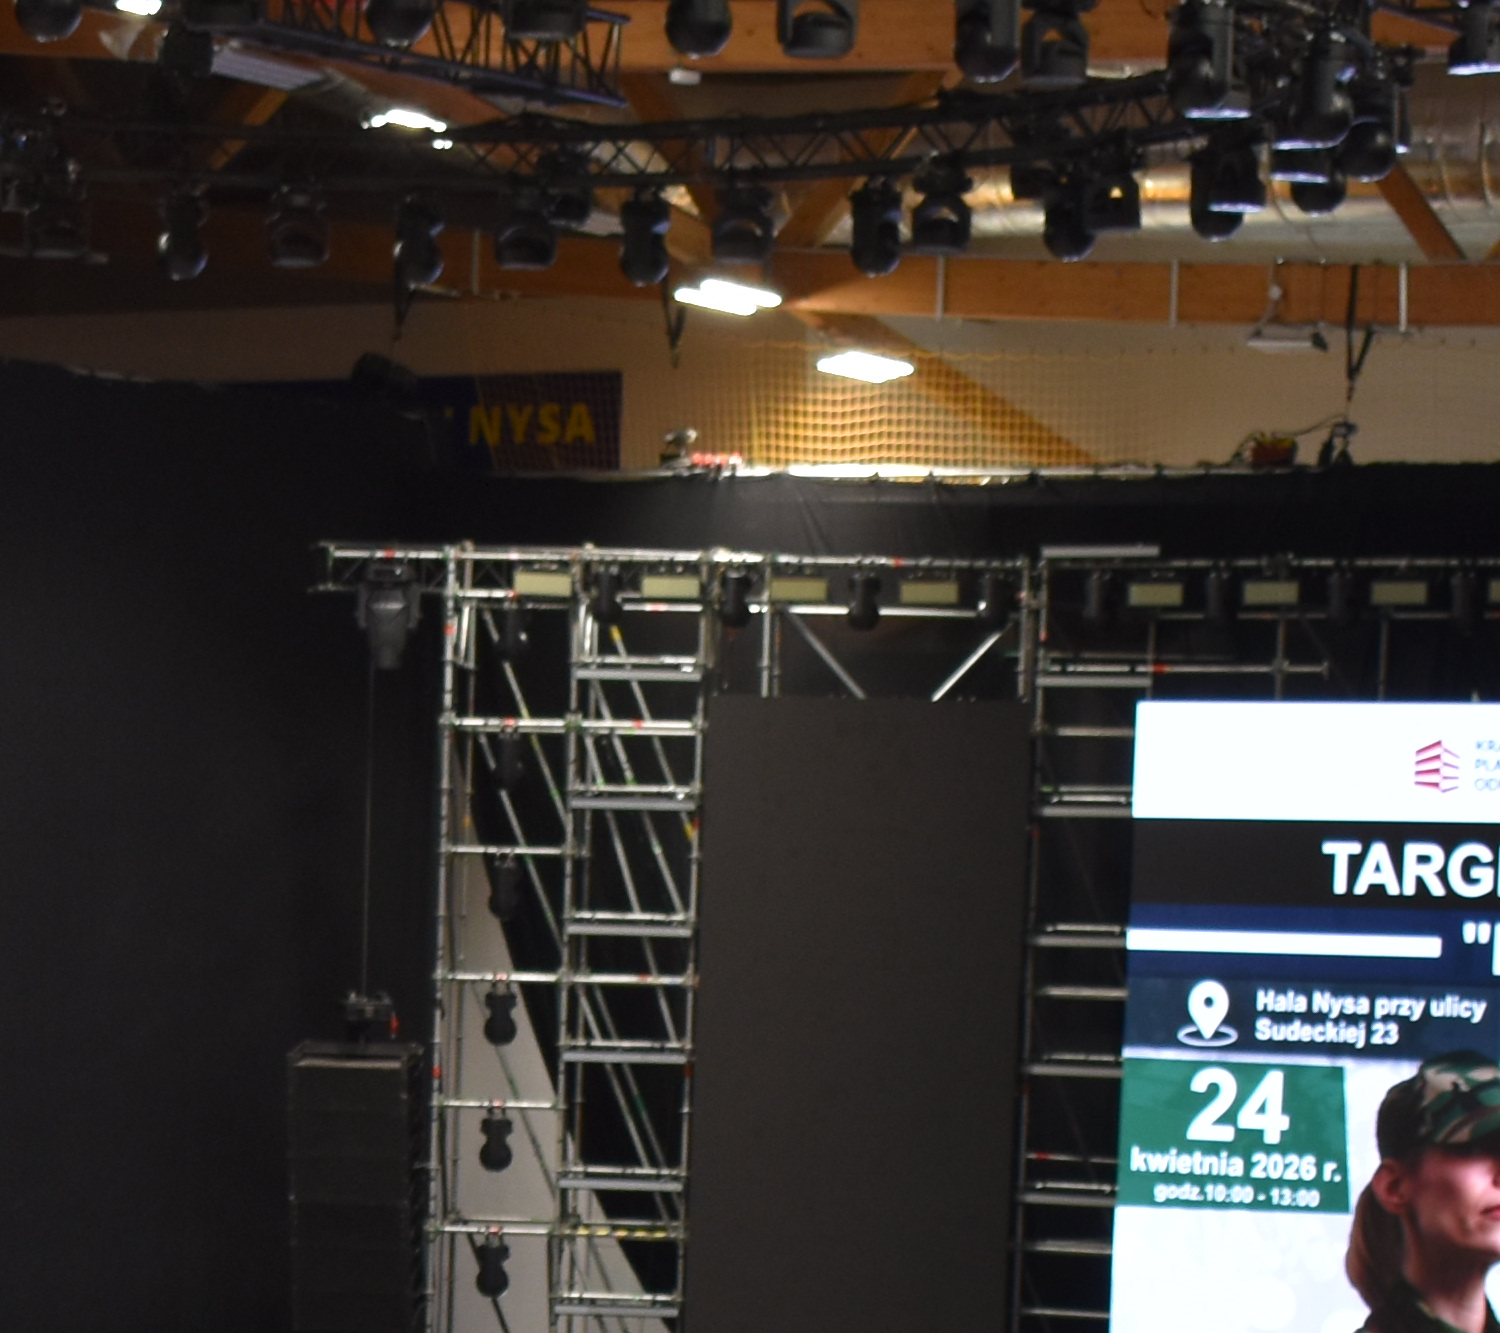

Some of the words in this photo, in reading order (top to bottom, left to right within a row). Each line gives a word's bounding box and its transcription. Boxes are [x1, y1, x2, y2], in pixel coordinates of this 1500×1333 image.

[469, 404, 597, 446] NYSA
[1256, 990, 1309, 1014] Hala
[1313, 992, 1371, 1019] Nysa
[1375, 996, 1426, 1021] przy
[1431, 993, 1487, 1023] ulicy
[1255, 1019, 1366, 1049] Sudeckiej
[1370, 1023, 1400, 1046] 23
[1185, 1067, 1291, 1145] 24
[1130, 1146, 1245, 1178] kwietnia
[1250, 1153, 1317, 1181] 2026
[1323, 1158, 1342, 1183] r.
[1271, 1187, 1321, 1208] 13:00
